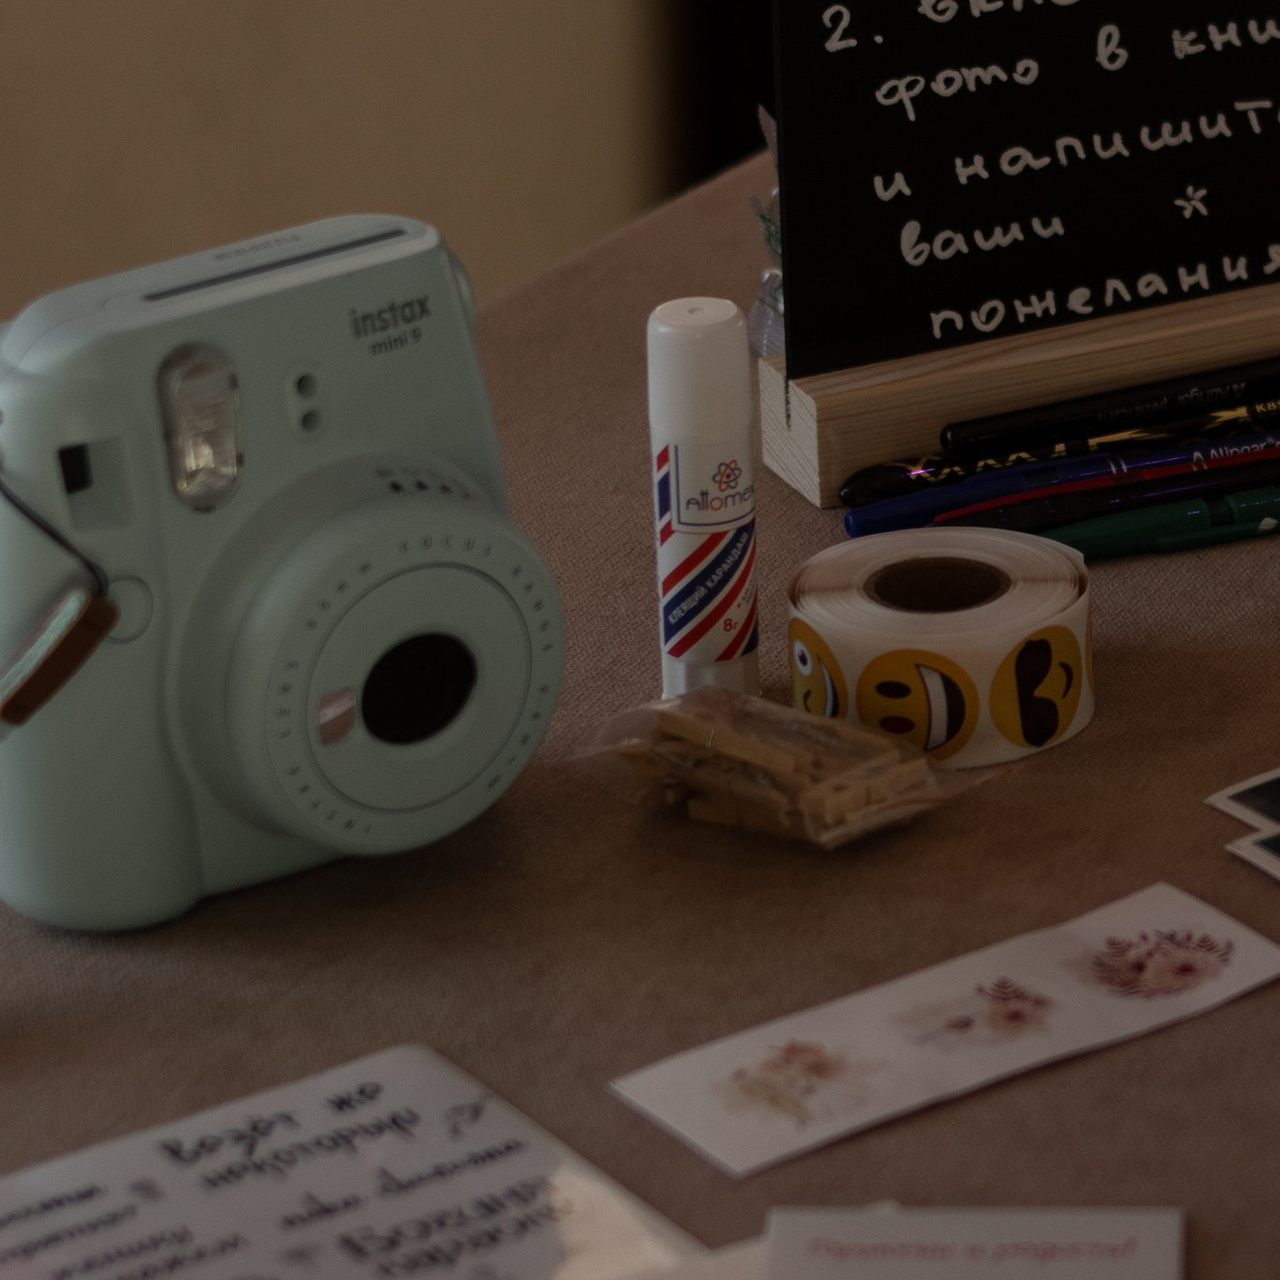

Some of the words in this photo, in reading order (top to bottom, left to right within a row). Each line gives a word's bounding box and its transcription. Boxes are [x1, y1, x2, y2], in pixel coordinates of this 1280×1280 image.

[823, 5, 883, 52] 2.
[875, 59, 1038, 121] фото
[1096, 25, 1128, 70] в
[874, 172, 911, 201] и
[901, 218, 1064, 266] ваши
[349, 296, 432, 338] instax
